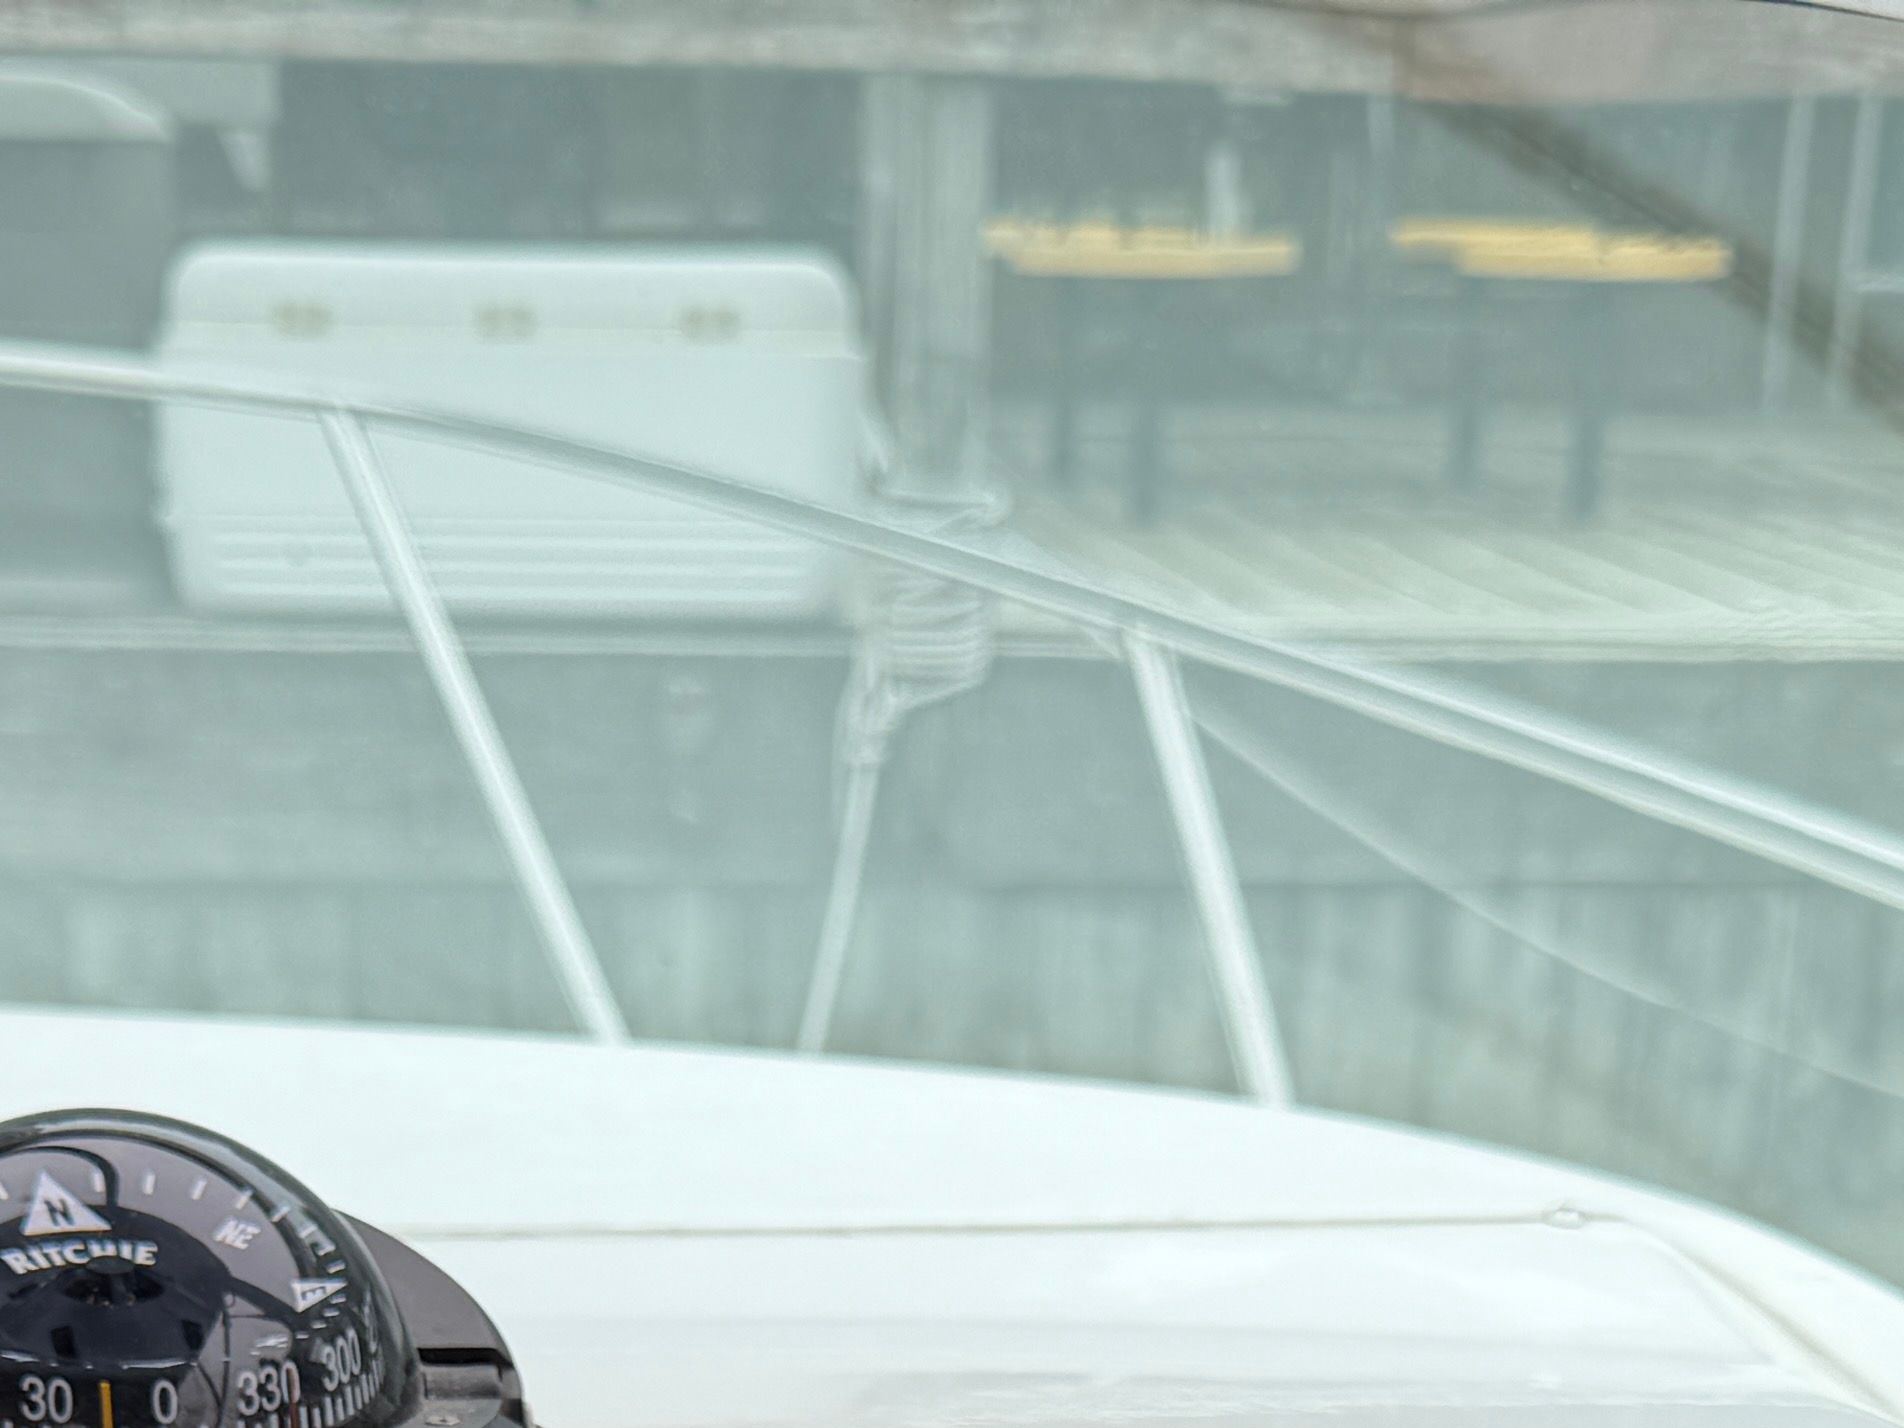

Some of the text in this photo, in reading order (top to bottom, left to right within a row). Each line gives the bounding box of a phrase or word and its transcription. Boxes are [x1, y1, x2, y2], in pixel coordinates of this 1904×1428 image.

[45, 1199, 75, 1228] N
[213, 1217, 261, 1249] NE
[0, 1239, 158, 1275] RITCHIE
[322, 1328, 361, 1391] 300
[19, 1374, 74, 1424] 30
[153, 1379, 178, 1424] 0
[237, 1359, 301, 1416] 330
